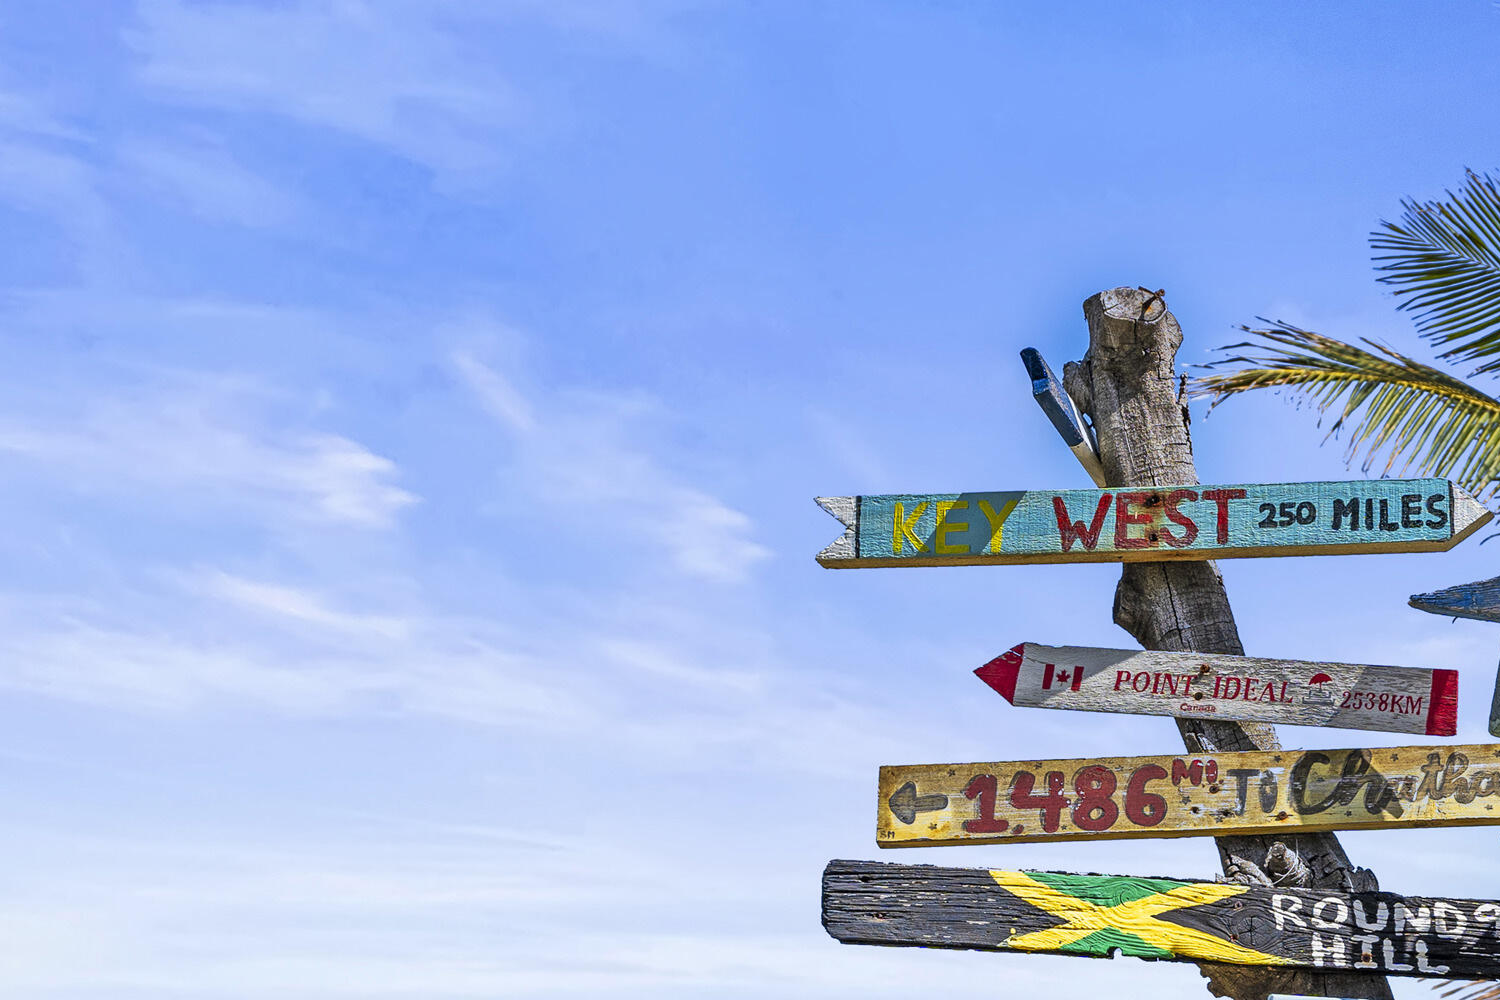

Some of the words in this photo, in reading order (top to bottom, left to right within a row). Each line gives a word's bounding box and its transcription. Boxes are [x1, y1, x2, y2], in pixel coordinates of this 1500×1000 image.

[892, 499, 1018, 554] KEY
[1052, 489, 1247, 552] WEST
[1258, 502, 1317, 529] 250
[1332, 494, 1448, 532] MILES
[1113, 670, 1197, 697] POINT
[1212, 676, 1293, 704] IDEAL
[1340, 691, 1423, 716] 2538KM
[1180, 703, 1217, 713] Canada
[1272, 894, 1467, 940] ROUND
[1311, 932, 1450, 975] HILL
